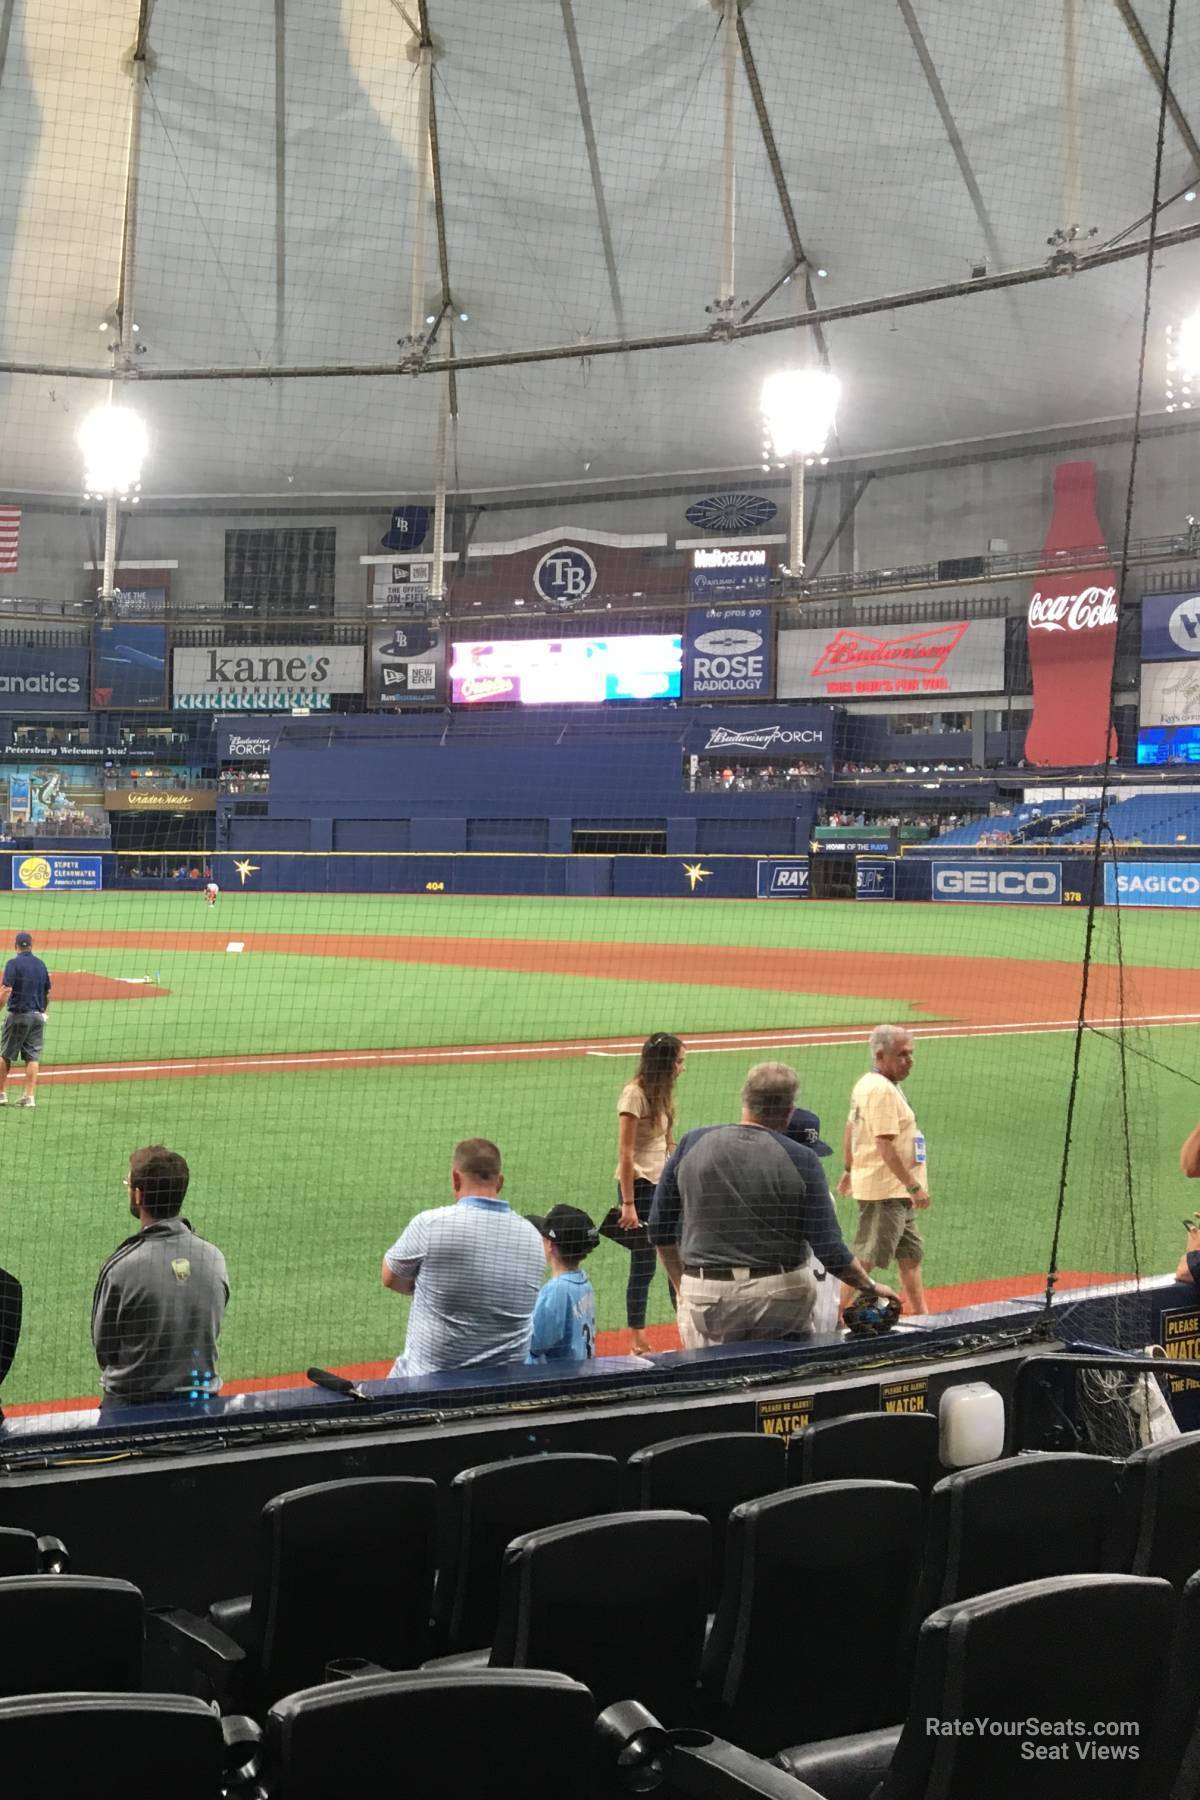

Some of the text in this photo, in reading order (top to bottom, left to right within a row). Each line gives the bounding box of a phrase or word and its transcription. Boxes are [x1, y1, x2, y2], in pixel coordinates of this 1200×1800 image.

[546, 558, 586, 595] TB
[725, 610, 746, 620] pros
[749, 609, 762, 618] go
[1028, 586, 1119, 632] Coca-Cola
[206, 650, 331, 683] kane's
[693, 656, 764, 679] ROSE
[412, 669, 433, 677] NEW
[412, 677, 433, 685] ERA
[693, 678, 763, 691] RADIOLOGY
[712, 731, 823, 744] Budweiser PORCH
[5, 746, 58, 756] Petersburg
[60, 746, 104, 755] Welcomes
[106, 747, 128, 755] You!
[229, 744, 271, 755] PORCH
[825, 843, 889, 851] HOME OF THE RAYS
[426, 881, 445, 891] 404
[936, 871, 1057, 895] GEICO
[1064, 892, 1081, 902] 378
[1168, 1318, 1199, 1335] PLEASE
[1171, 1380, 1185, 1392] THE
[761, 1404, 783, 1413] PLEASE
[783, 1402, 791, 1411] BE
[885, 1396, 925, 1412] WATCH
[763, 1414, 809, 1435] WATCH
